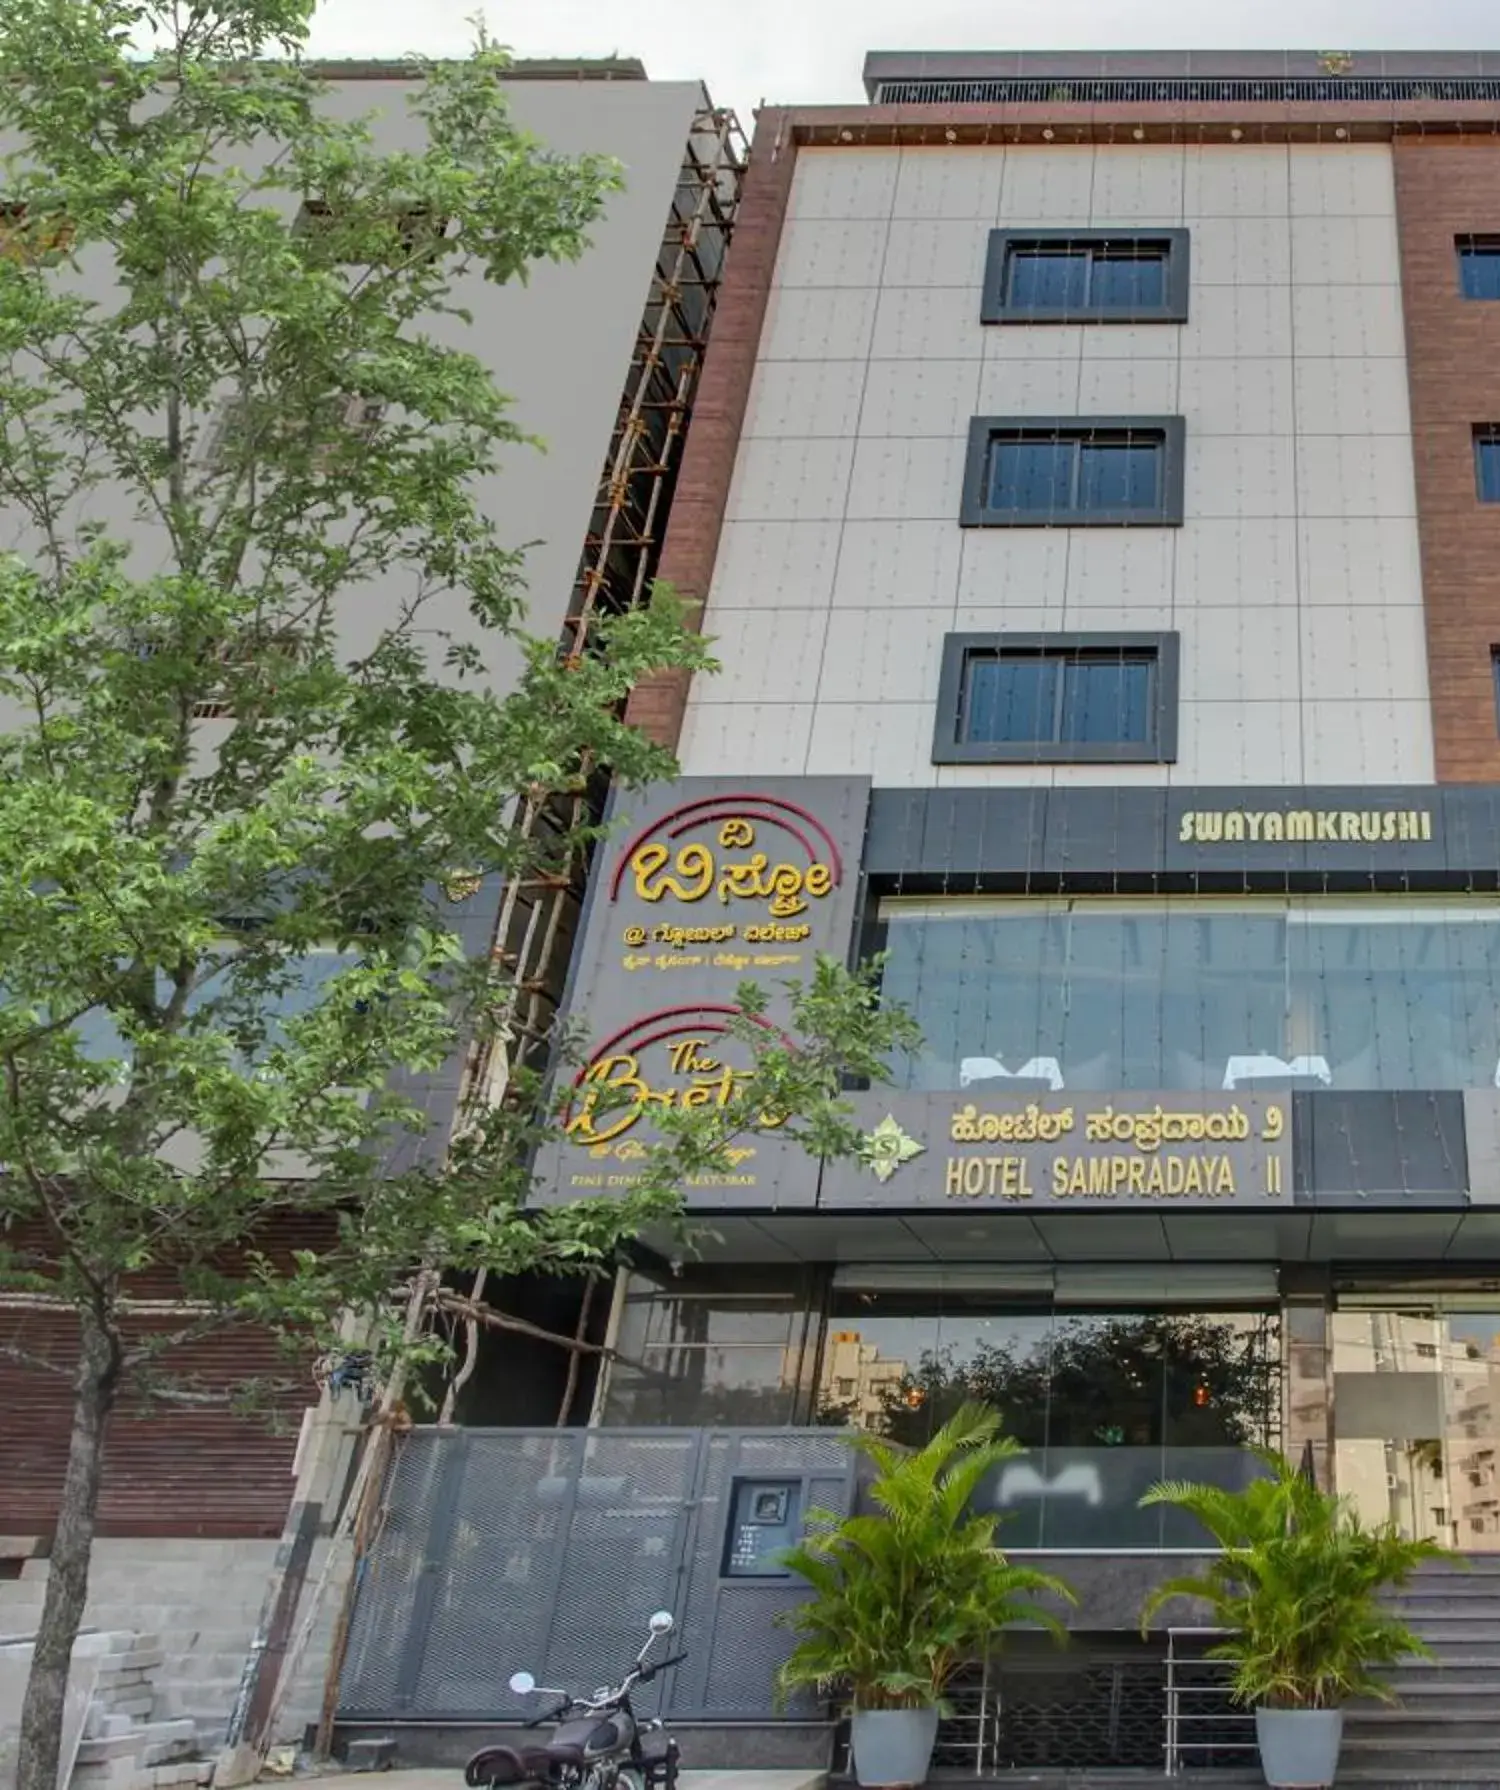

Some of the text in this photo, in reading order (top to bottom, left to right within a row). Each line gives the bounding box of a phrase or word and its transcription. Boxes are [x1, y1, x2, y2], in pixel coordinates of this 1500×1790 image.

[1179, 810, 1432, 842] SWAYAMKRUSHI
[623, 926, 646, 946] @
[667, 1039, 721, 1074] The
[951, 1104, 1074, 1141] ಹೋಟೆಲ್
[1086, 1104, 1249, 1152] ಸಂಪ್ರದಾಯ
[945, 1156, 1034, 1197] HOTEL
[1052, 1155, 1236, 1197] SAMPRADAYA
